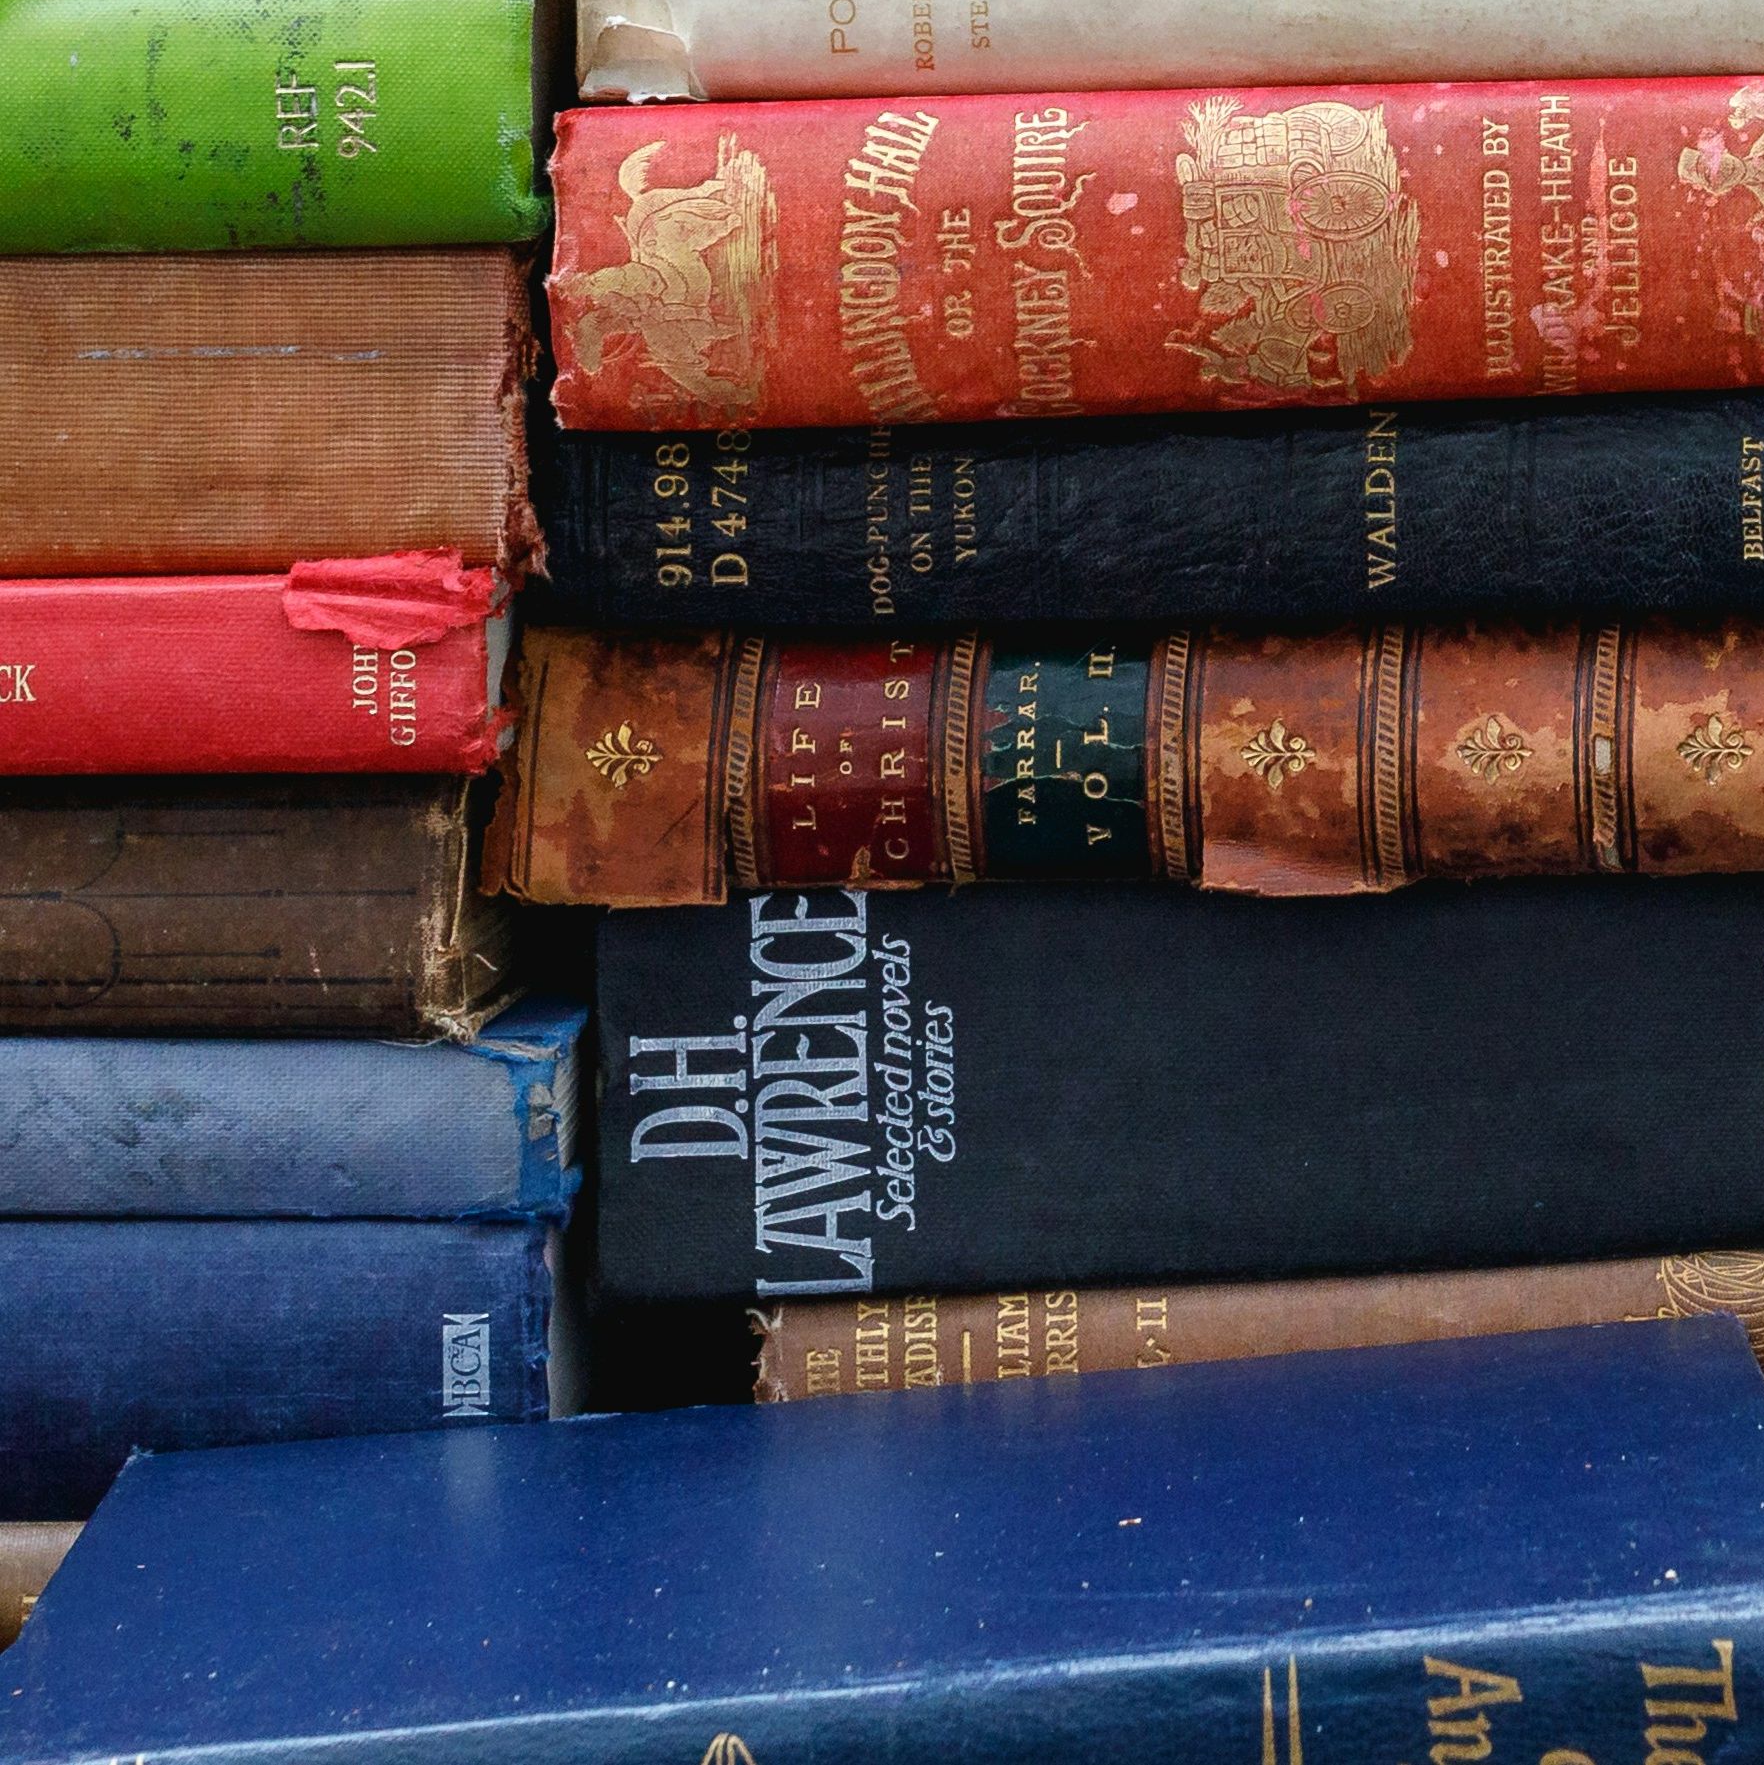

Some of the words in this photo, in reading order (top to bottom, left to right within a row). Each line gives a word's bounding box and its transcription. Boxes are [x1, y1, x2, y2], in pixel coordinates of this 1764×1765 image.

[275, 72, 319, 150] REF
[335, 59, 377, 158] 942.1
[1482, 116, 1510, 158] BY
[654, 442, 692, 588] 914.98
[710, 427, 753, 539] 4748
[951, 456, 978, 565] YUKON
[1366, 408, 1399, 589] WALDEN
[390, 647, 417, 746] GIFFO
[791, 682, 821, 830] LIFE
[881, 638, 918, 861] CHRIST
[1082, 704, 1112, 847] VOL.
[872, 934, 912, 1059] novels
[750, 890, 874, 1296] LAWRENCE
[919, 1001, 956, 1124] stories
[874, 1059, 915, 1230] Selected
[917, 1125, 956, 1163] &
